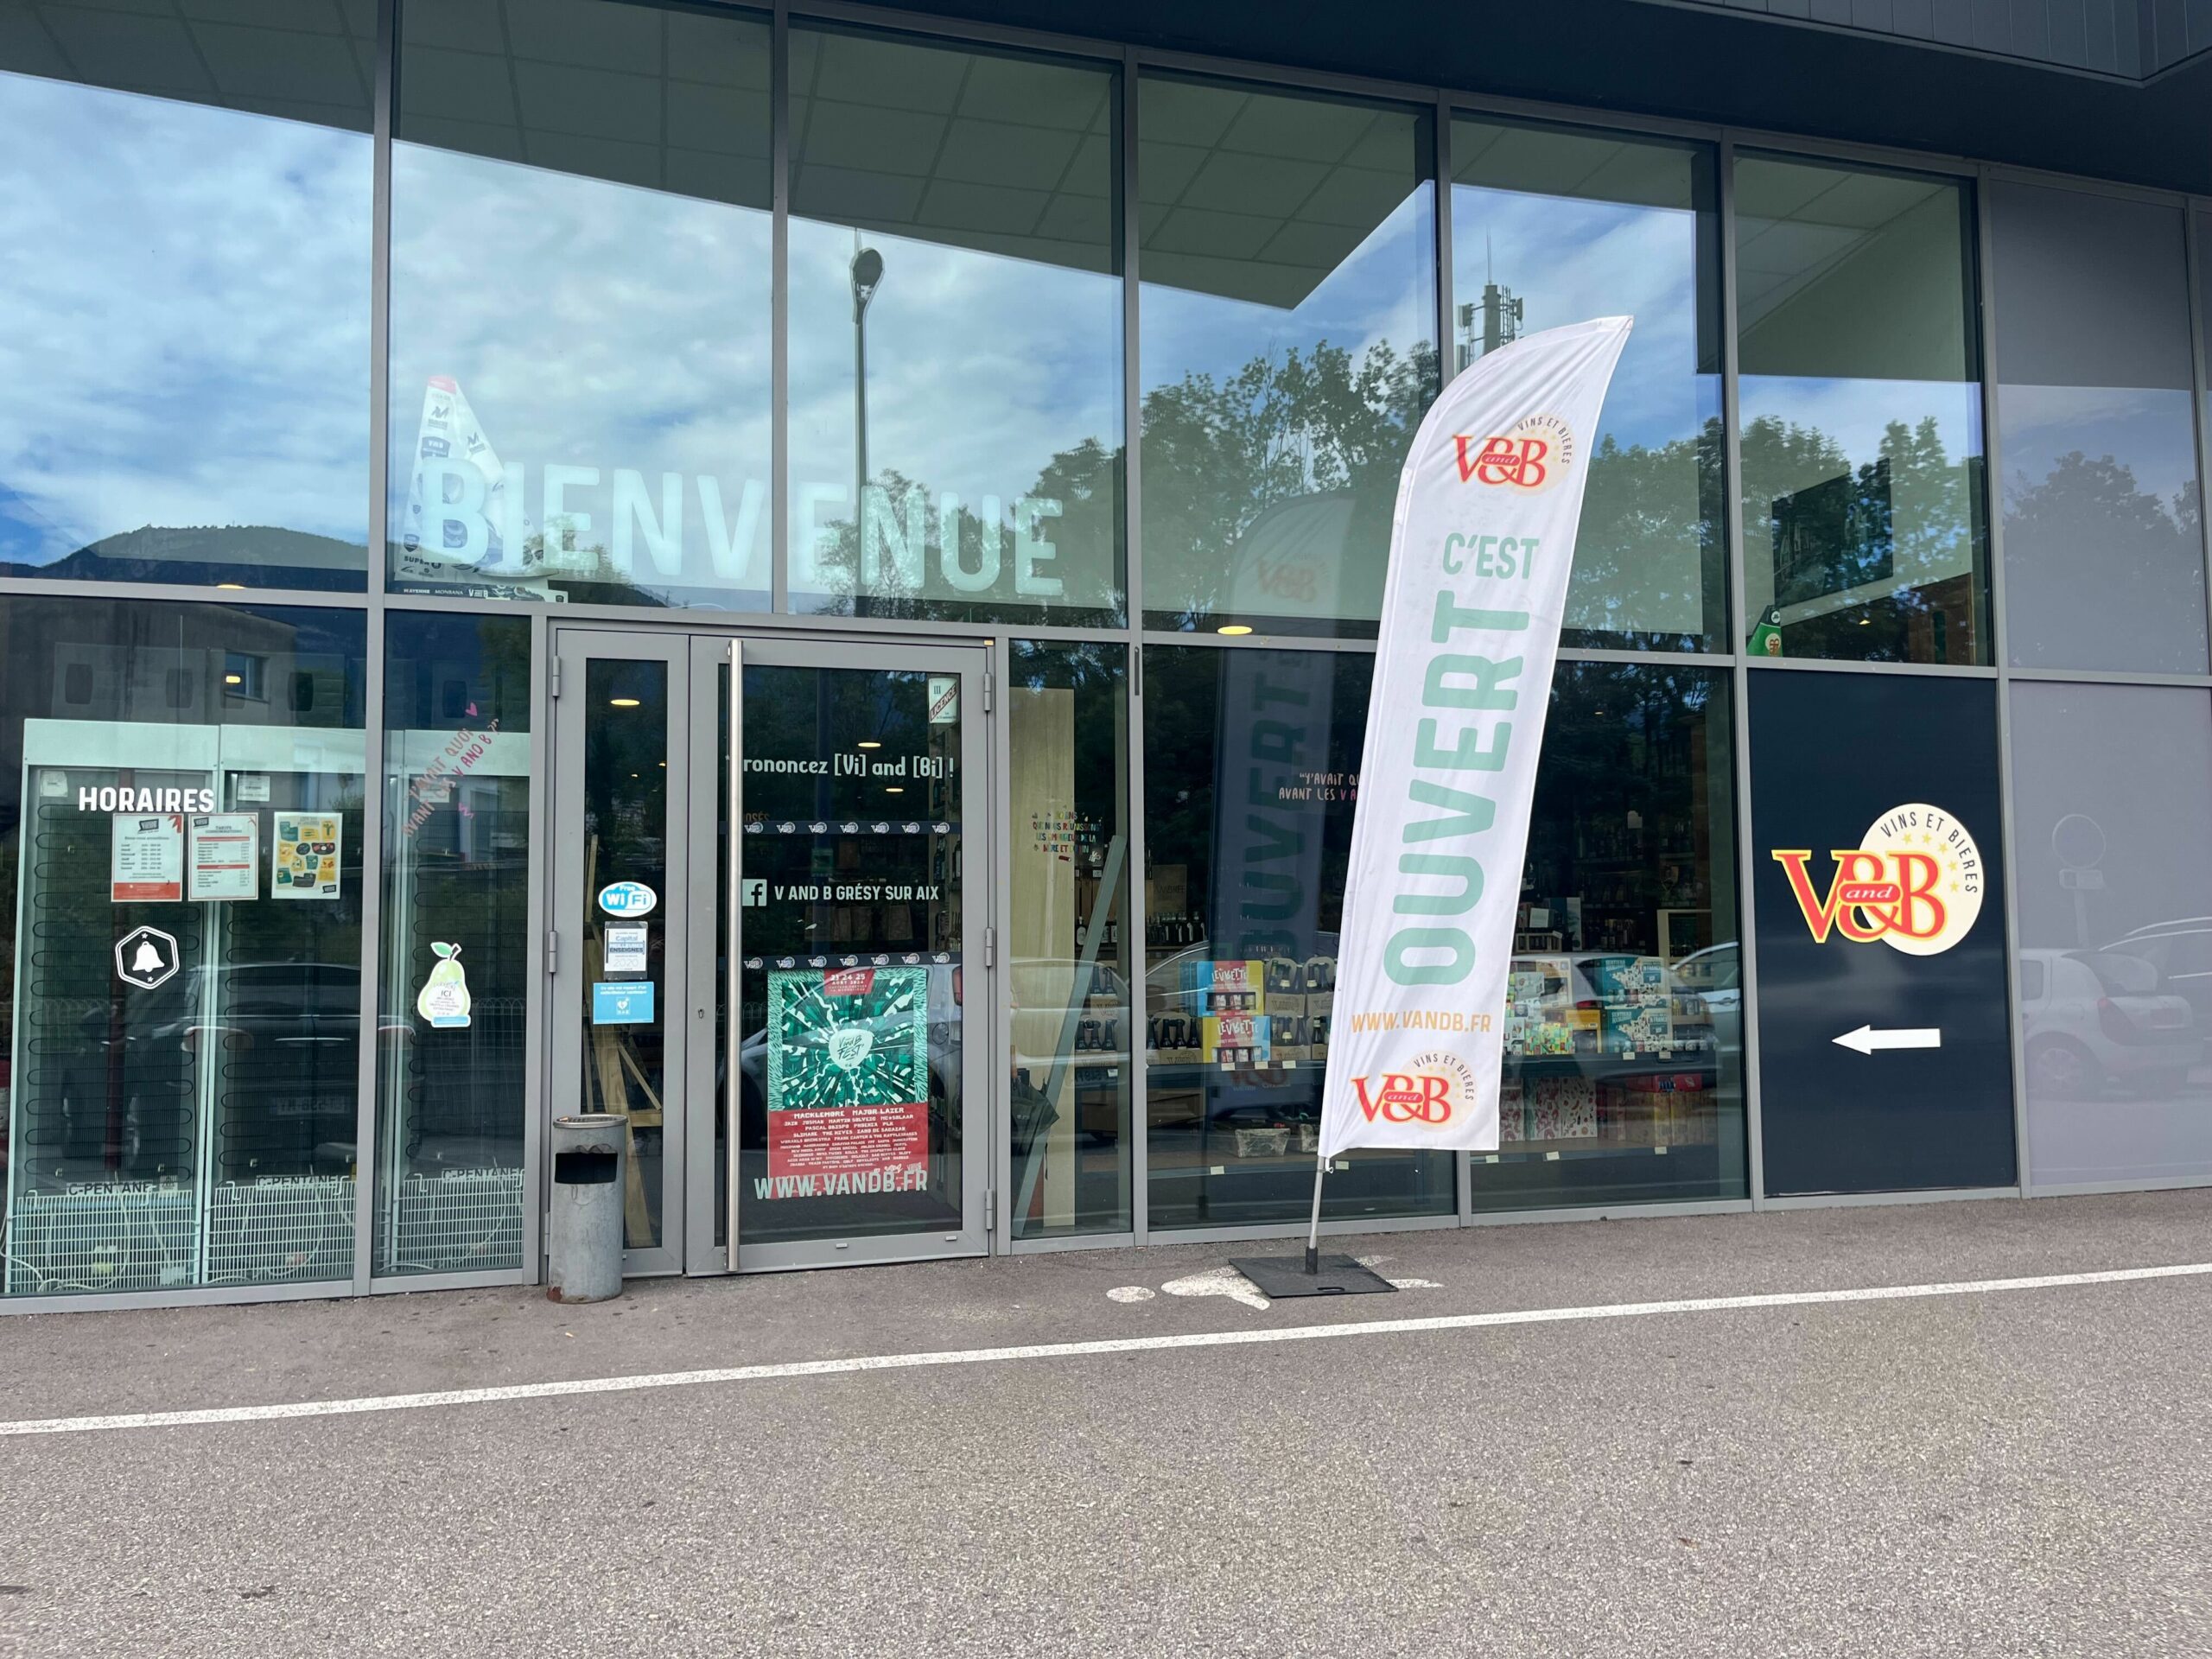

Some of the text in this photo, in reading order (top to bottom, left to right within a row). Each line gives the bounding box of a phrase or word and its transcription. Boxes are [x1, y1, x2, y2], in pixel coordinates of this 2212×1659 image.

[1518, 416, 1572, 464] VINS ET BIERES
[1485, 454, 1516, 464] and
[422, 456, 1064, 597] BIENVENUE
[1443, 532, 1540, 580] C'EST
[931, 684, 956, 720] LICENCE
[451, 766, 464, 777] V
[460, 743, 484, 767] AND
[479, 734, 492, 745] B
[743, 758, 828, 774] rononcez
[872, 756, 906, 776] and
[79, 786, 215, 813] HORAIRES
[1279, 787, 1312, 800] AVANT
[1317, 788, 1336, 800] LES
[1340, 789, 1346, 801] V
[1383, 590, 1529, 985] OUVERT
[1880, 811, 1978, 893] VINS ET BIERES
[774, 883, 939, 900] V AND B GRÉSY SUR AIX
[1846, 886, 1893, 899] and
[1351, 1011, 1491, 1033] WWW.VANDB.FR
[1414, 1053, 1474, 1101] VINS ET BIERES
[1387, 1092, 1420, 1102] and
[754, 1170, 928, 1200] WWW.VANDB.FR
